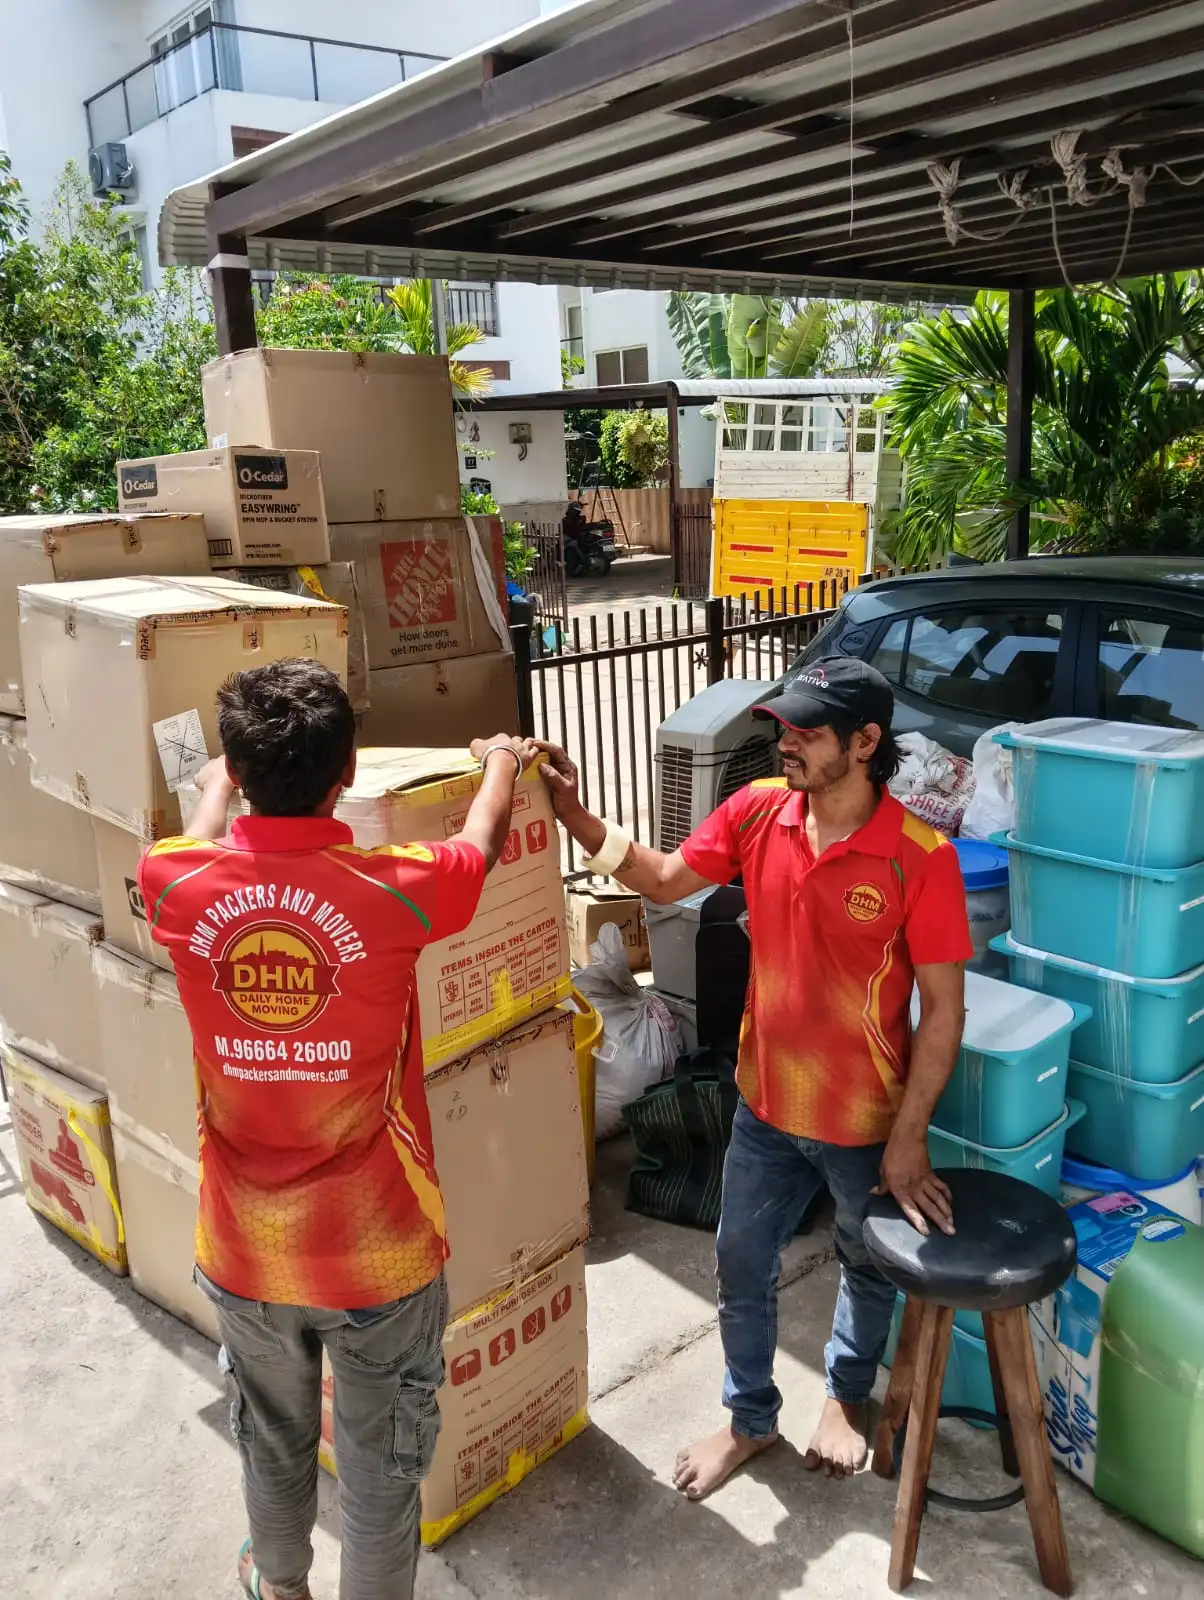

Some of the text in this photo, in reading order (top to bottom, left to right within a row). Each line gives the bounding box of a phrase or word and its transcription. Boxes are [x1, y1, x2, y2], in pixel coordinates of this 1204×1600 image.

[399, 628, 449, 642] How doers
[409, 643, 433, 654] more
[906, 792, 950, 818] SHREE
[851, 894, 880, 911] DHM
[188, 884, 367, 964] DHM PACKERS AND MOVERS
[441, 956, 472, 976] ITEMS
[476, 942, 506, 962] INSIDE
[508, 933, 525, 947] THE
[526, 916, 556, 938] CARTON
[233, 964, 315, 992] DHM
[239, 993, 311, 1006] DAILY HOME
[252, 1005, 300, 1016] MOVING
[214, 1035, 352, 1063] M.96664 26000
[222, 1062, 348, 1084] dhmpackersandmovers.com
[473, 1311, 499, 1330] MULTI
[538, 1273, 552, 1288] BOX
[458, 1436, 490, 1460] ITEMS
[492, 1411, 523, 1438] INSIDE
[526, 1396, 542, 1413] THE
[544, 1366, 575, 1398] CARTON
